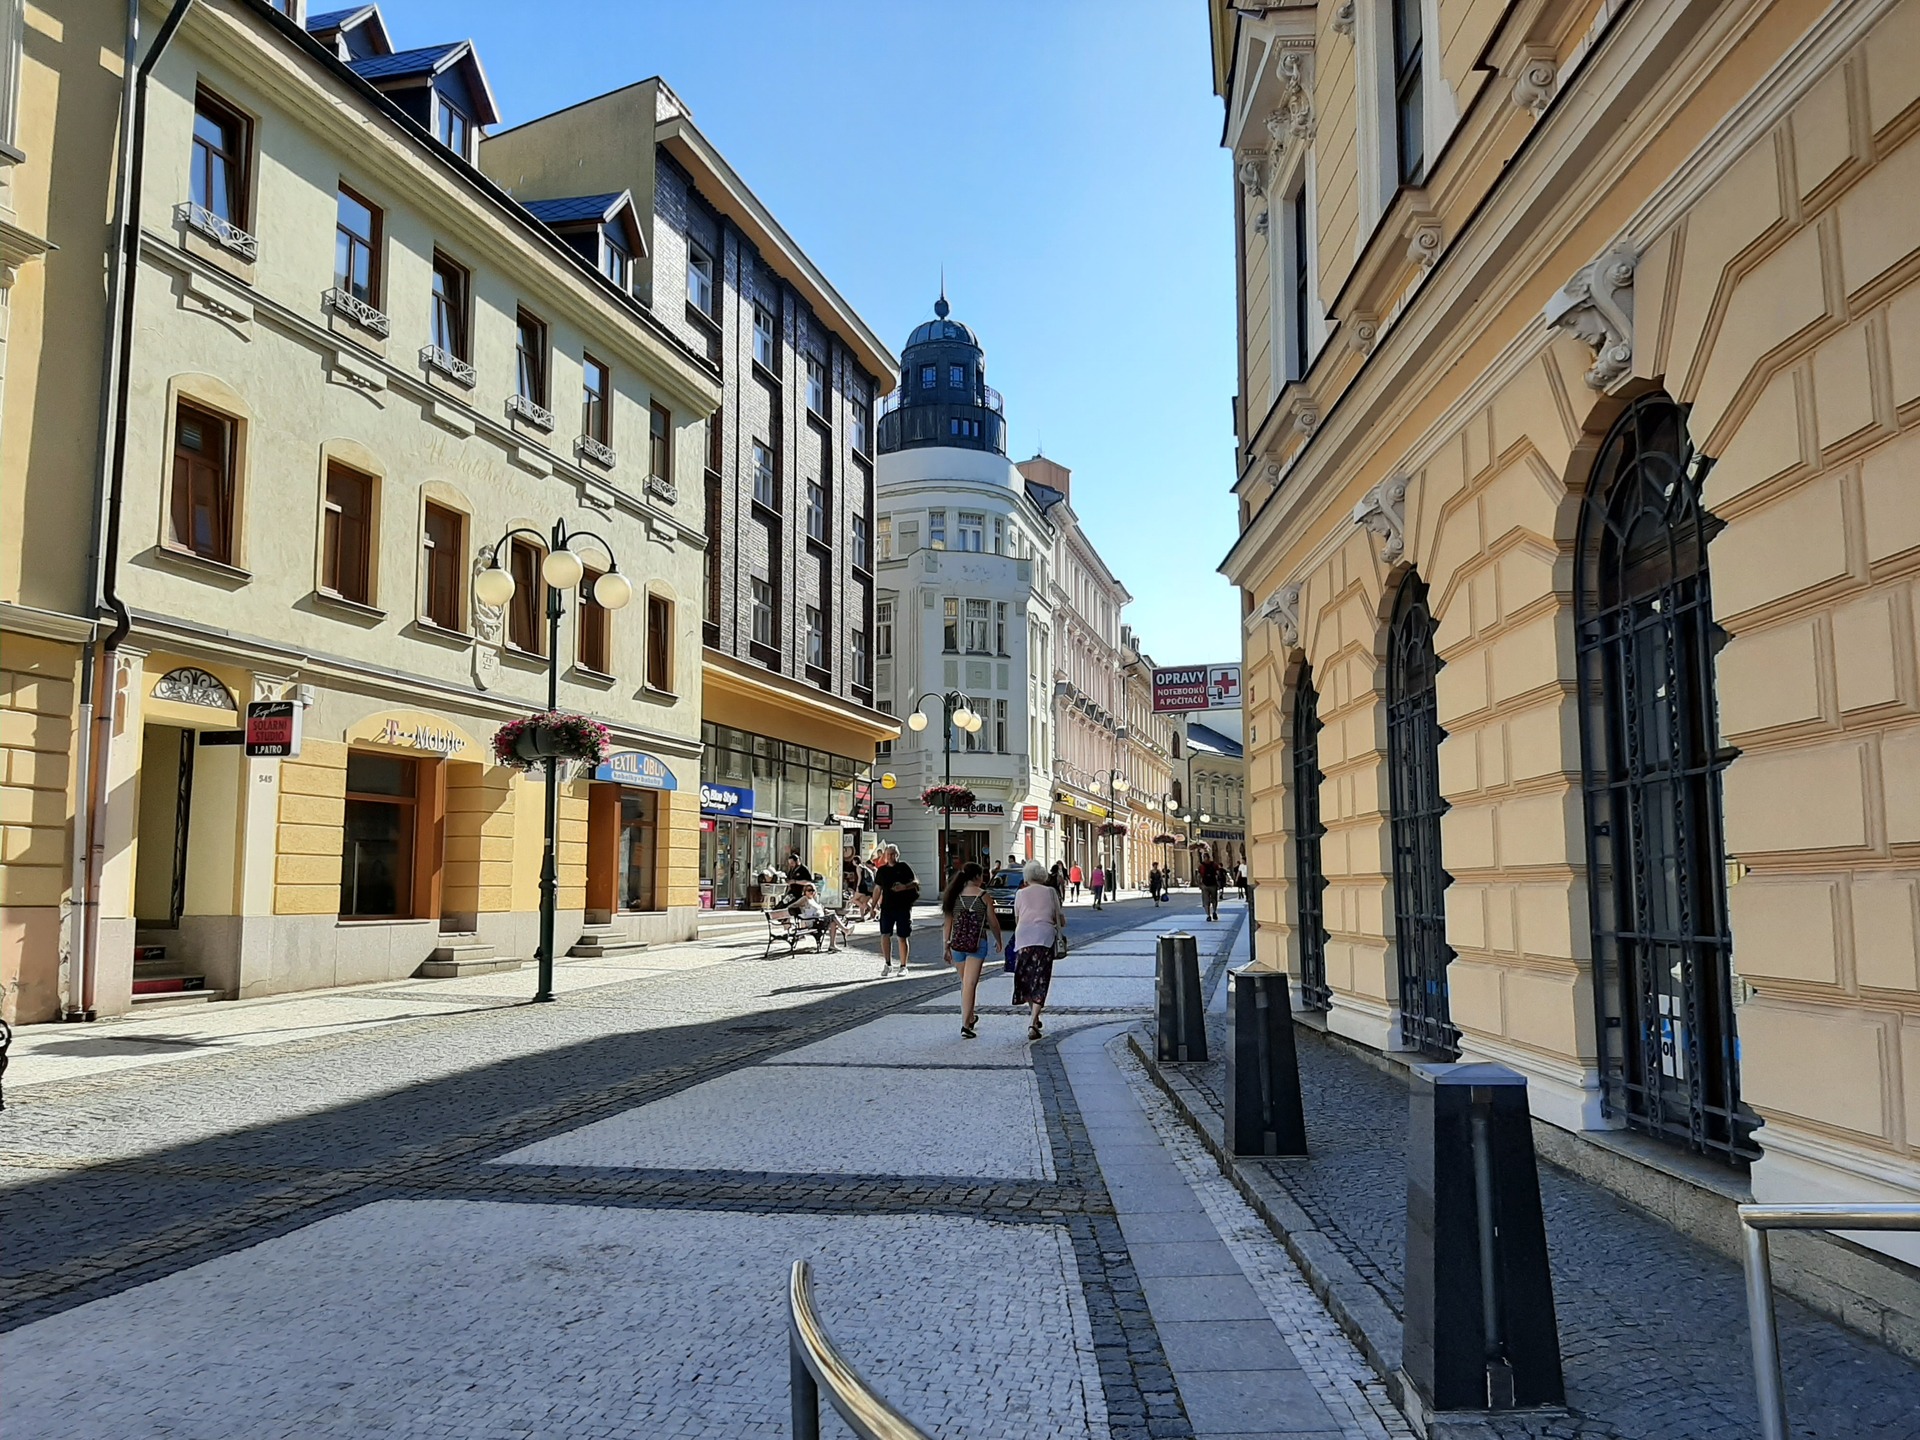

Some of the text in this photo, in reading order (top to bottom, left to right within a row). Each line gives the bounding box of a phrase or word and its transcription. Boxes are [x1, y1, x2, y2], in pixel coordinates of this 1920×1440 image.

[1156, 671, 1204, 685] OPRAVY
[1157, 685, 1205, 696] NOTEBOOKŮ
[255, 731, 285, 741] STUDIO
[611, 754, 666, 777] TEXTIL OBUV
[711, 789, 722, 802] Blue
[723, 791, 738, 806] Style
[987, 803, 1004, 813] Bank
